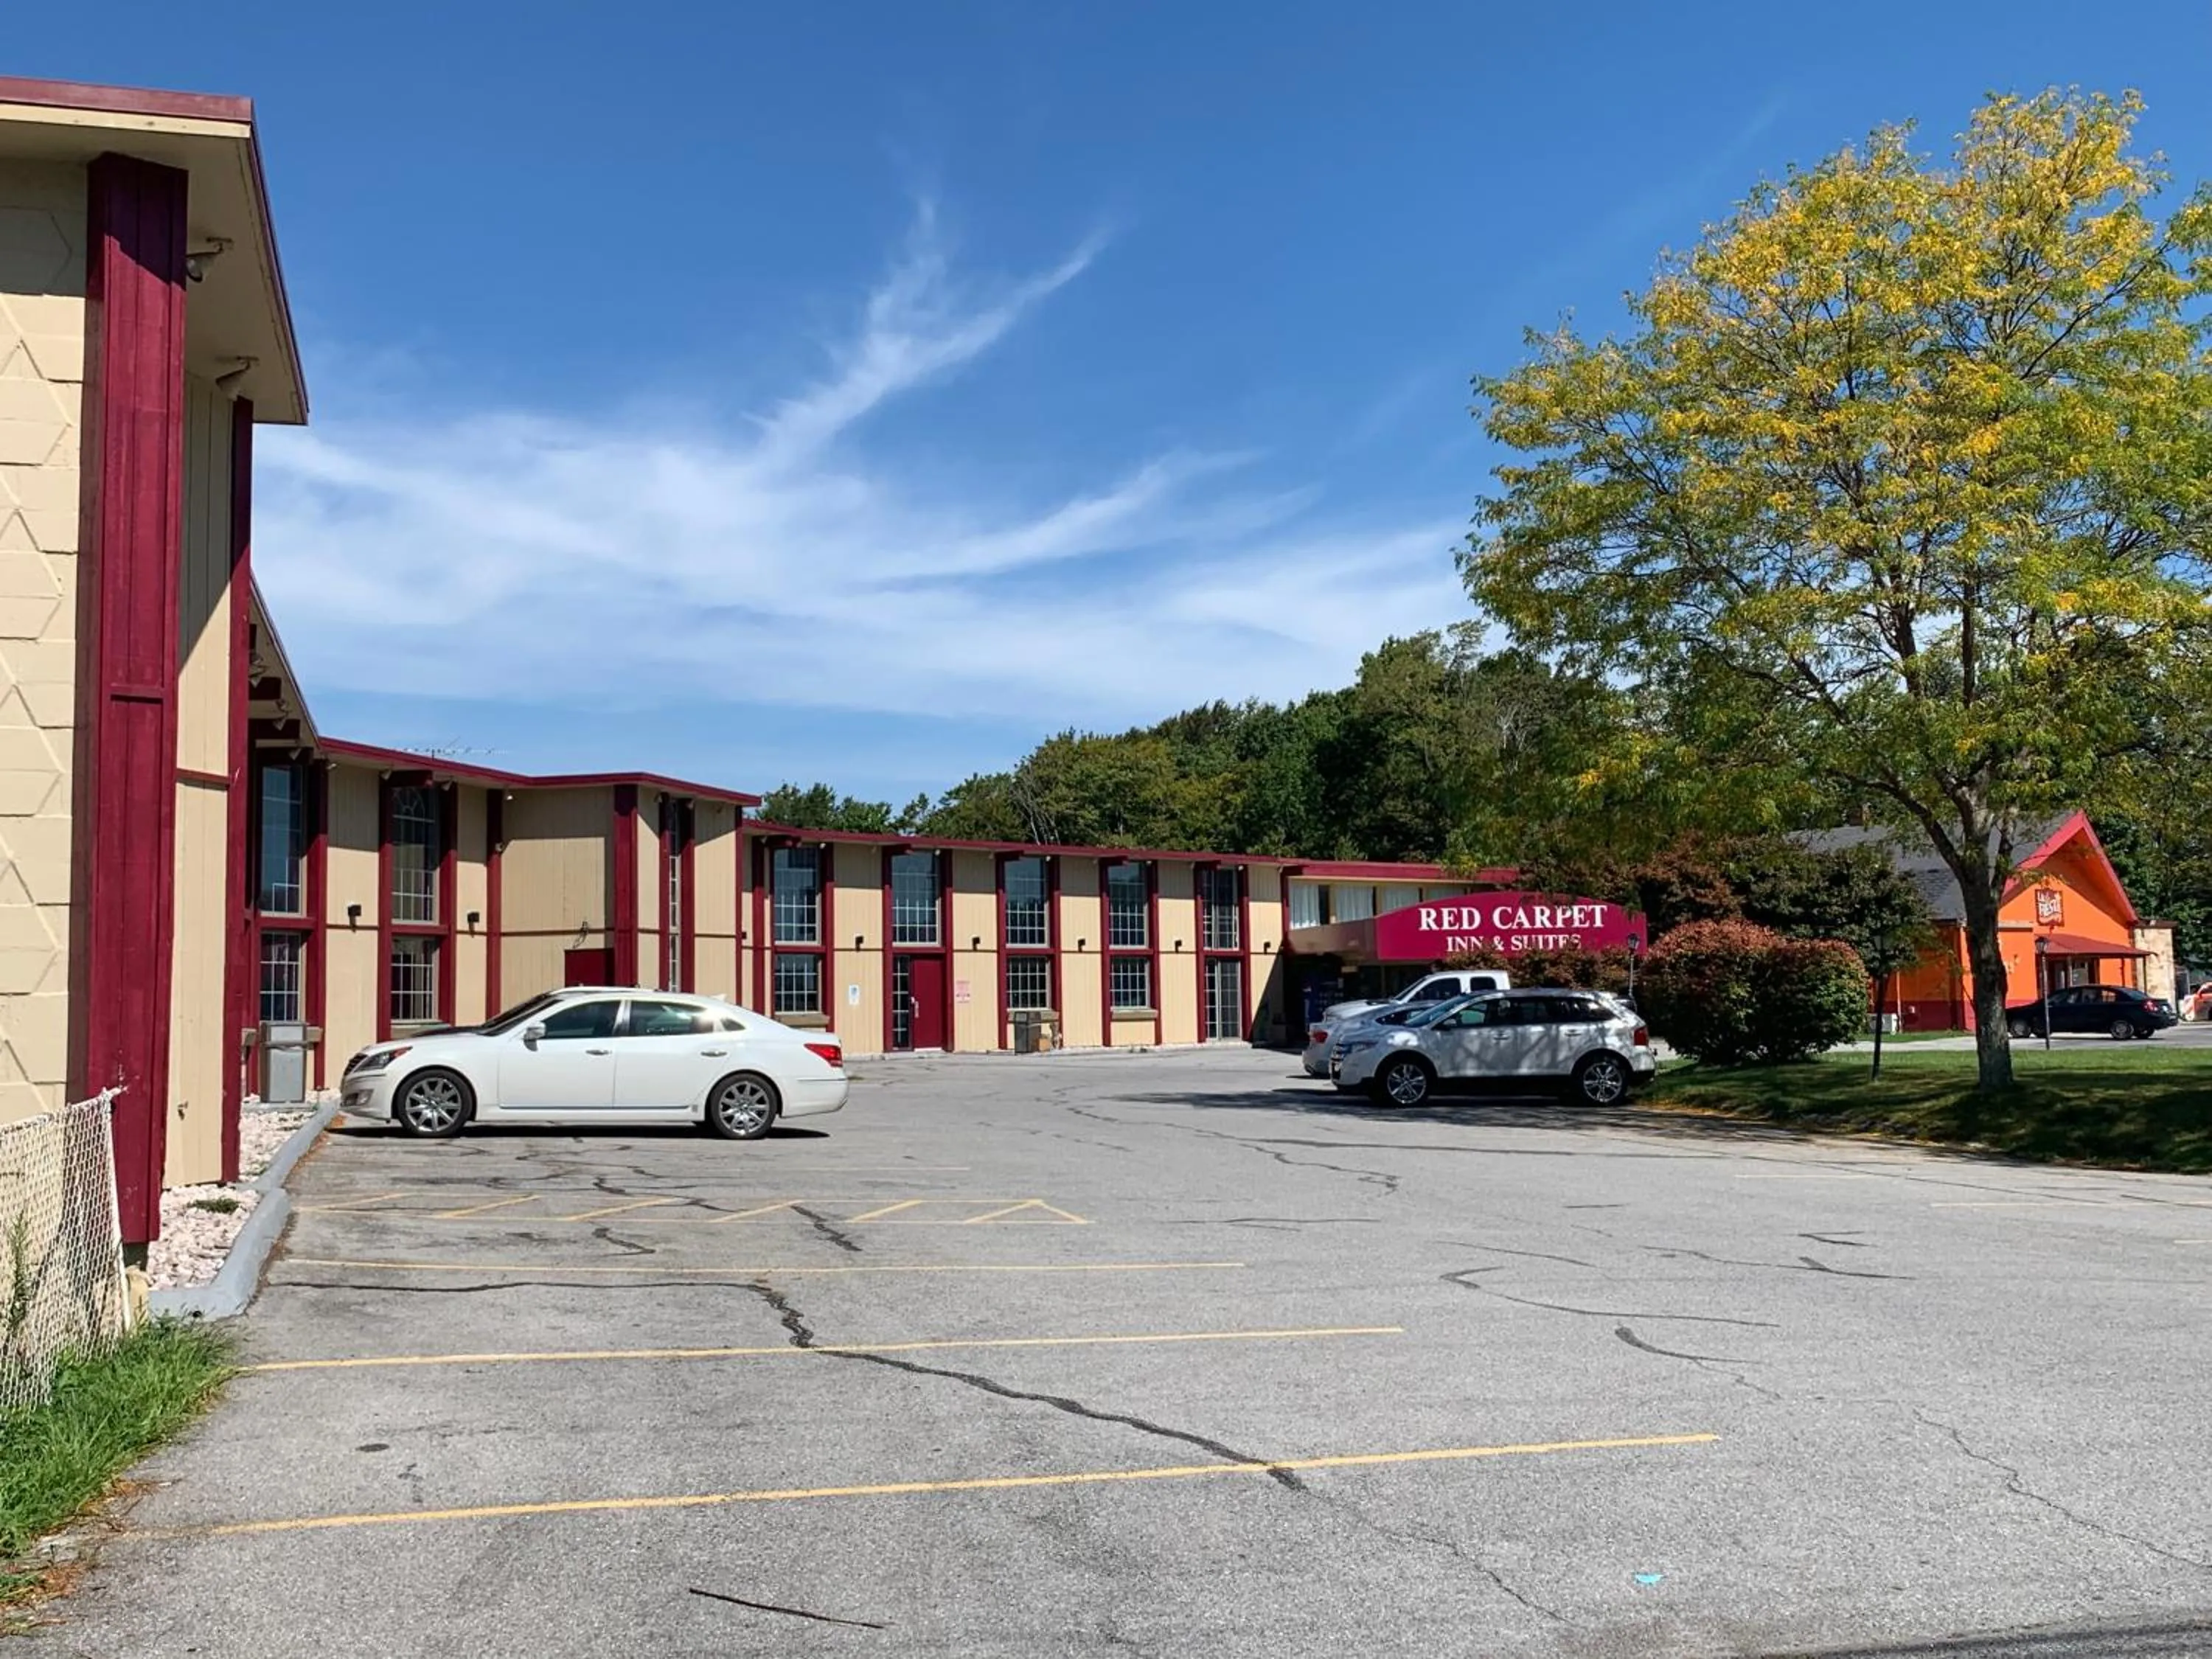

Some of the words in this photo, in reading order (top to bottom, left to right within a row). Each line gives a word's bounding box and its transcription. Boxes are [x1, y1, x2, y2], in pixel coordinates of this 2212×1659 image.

[1419, 908, 1481, 931] RED
[1492, 905, 1607, 929] CARPET
[1446, 936, 1484, 952] INN
[1493, 936, 1505, 951] &
